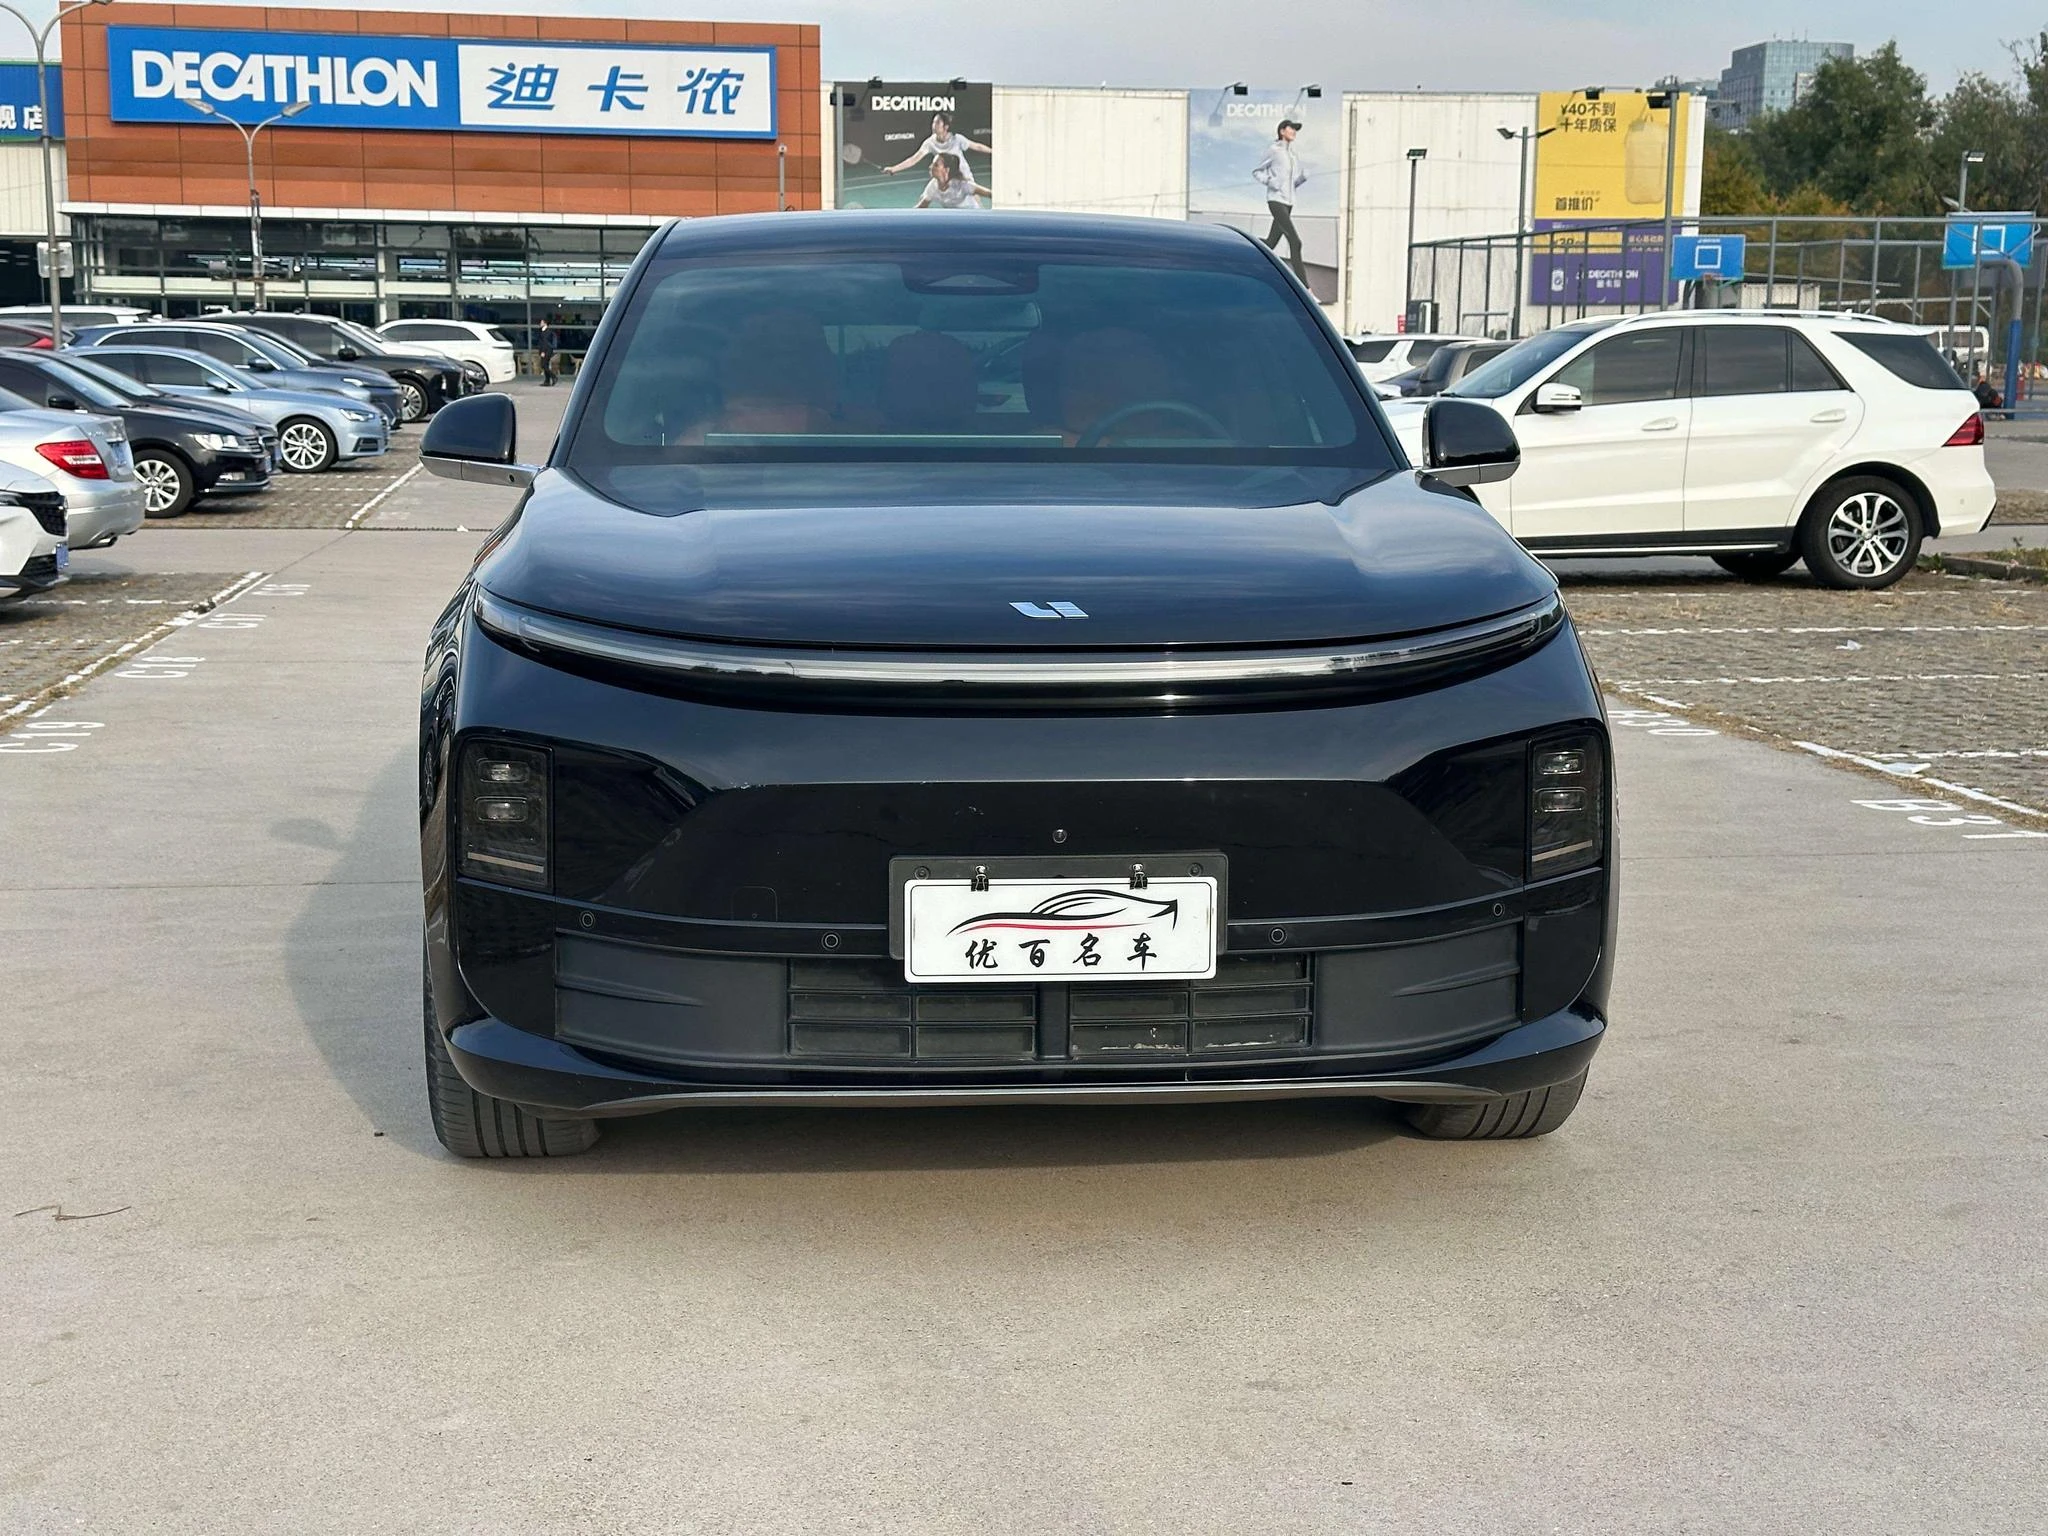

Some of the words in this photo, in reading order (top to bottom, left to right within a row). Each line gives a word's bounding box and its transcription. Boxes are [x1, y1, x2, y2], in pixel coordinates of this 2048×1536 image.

[132, 50, 438, 108] DECATHLON
[485, 62, 745, 115] 迪卡侬
[871, 95, 956, 112] DECATHLON
[1561, 102, 1616, 116] ¥40不到
[1560, 117, 1617, 132] 十年质保
[114, 656, 206, 679] C18
[0, 721, 106, 753] C19
[1849, 799, 2048, 839] B31
[964, 932, 1158, 971] 优百名车
